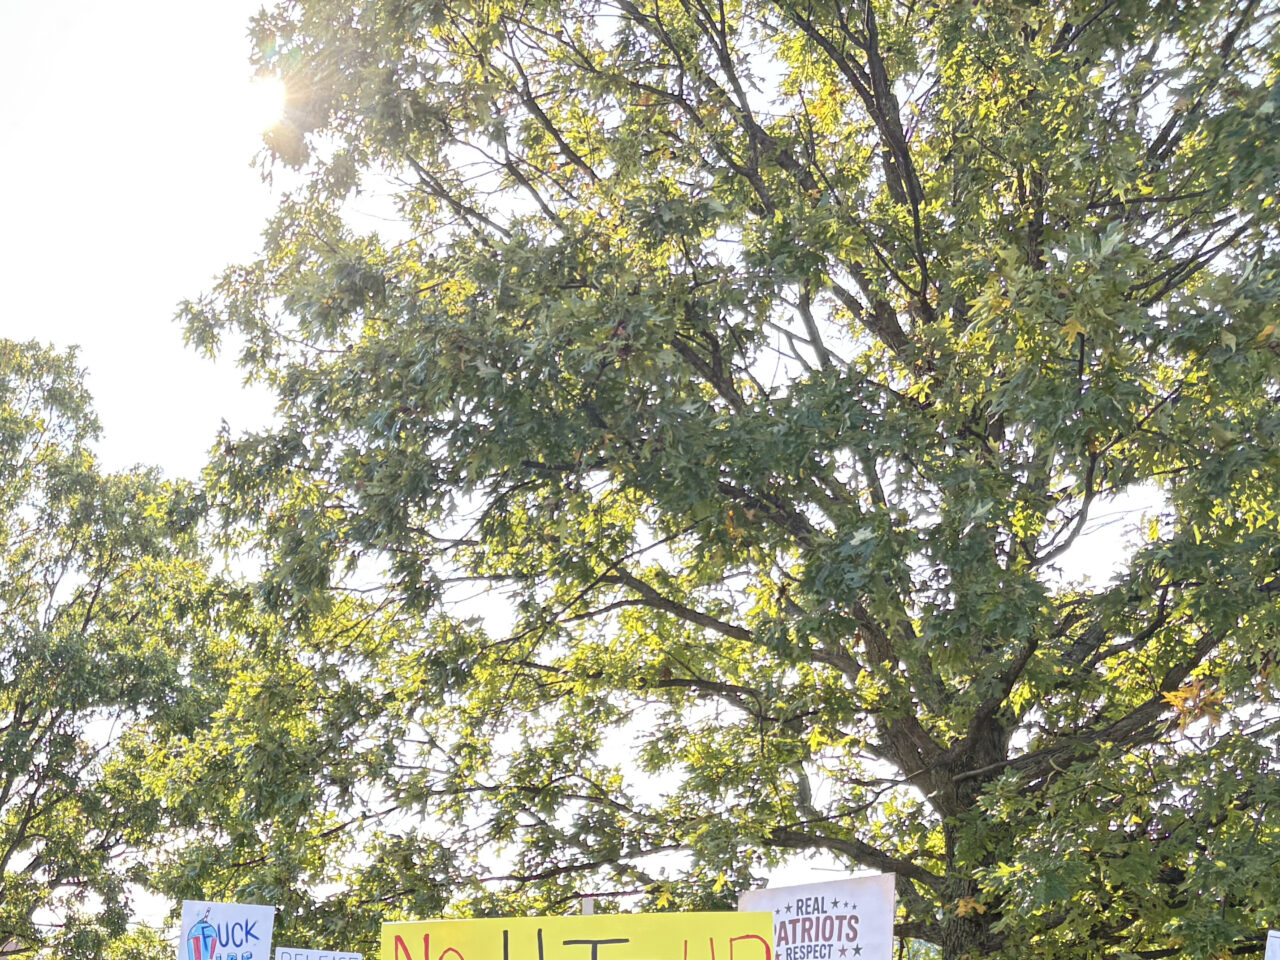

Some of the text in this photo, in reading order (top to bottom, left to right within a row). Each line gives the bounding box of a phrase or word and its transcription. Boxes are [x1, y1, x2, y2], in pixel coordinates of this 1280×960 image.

[796, 896, 828, 916] REAL
[202, 919, 260, 952] FUCK
[775, 915, 859, 947] ATRIOTS
